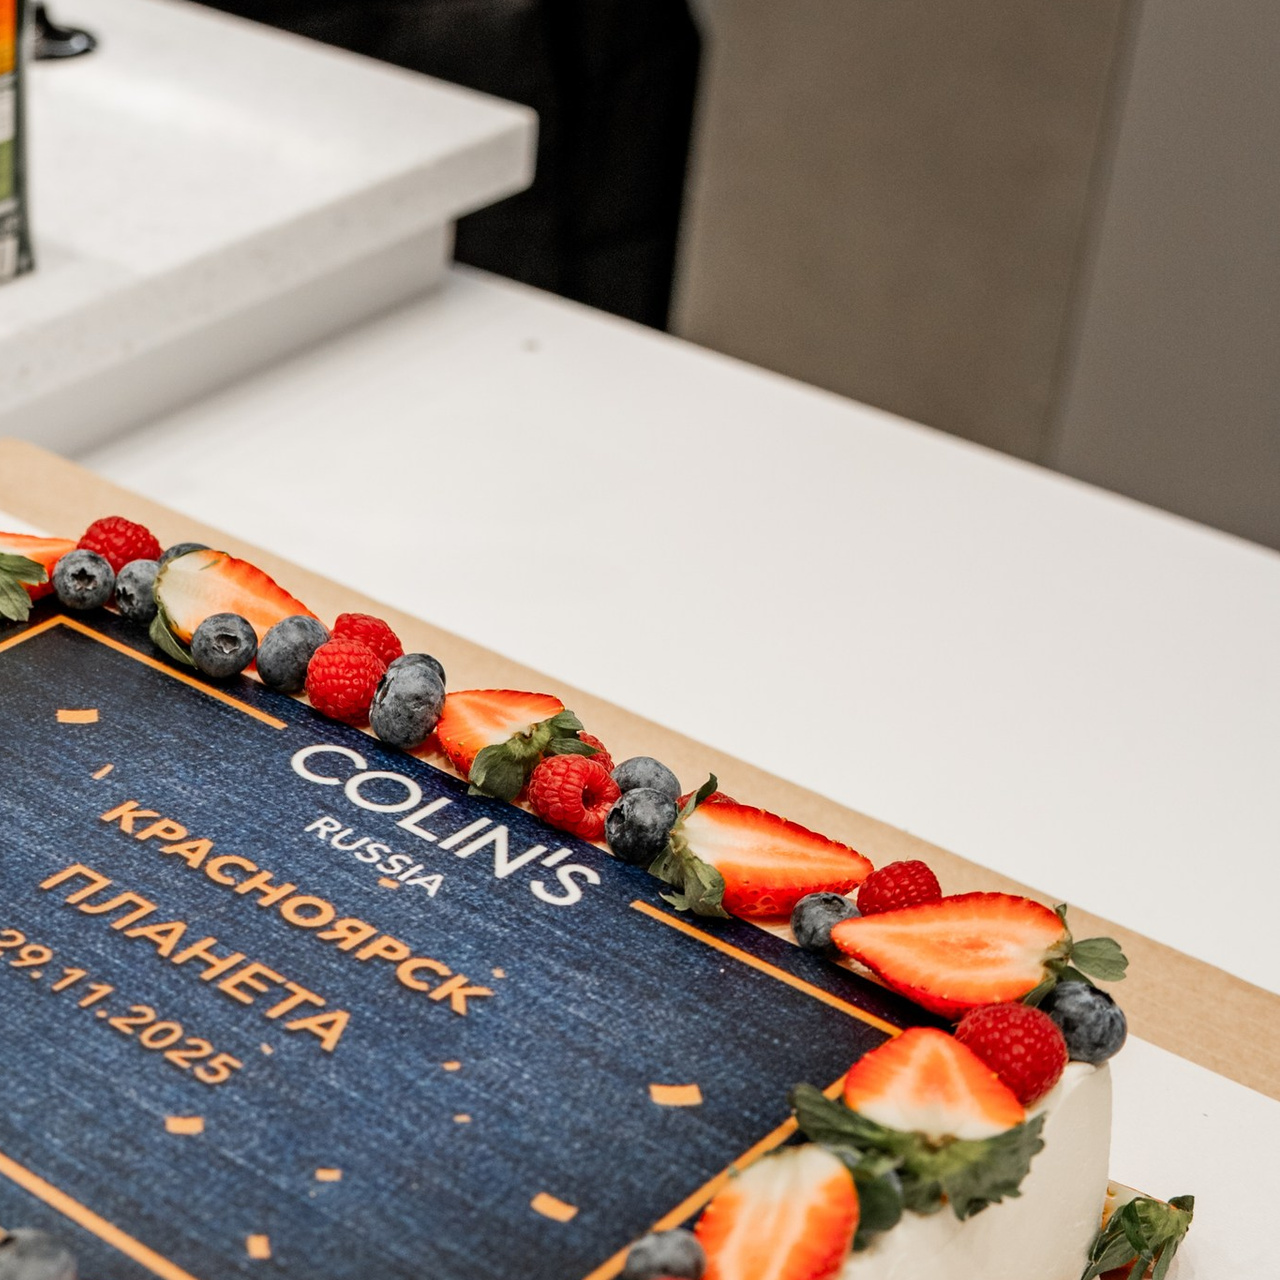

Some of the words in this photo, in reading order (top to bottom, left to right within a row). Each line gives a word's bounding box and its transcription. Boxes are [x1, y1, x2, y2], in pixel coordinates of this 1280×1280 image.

[100, 800, 494, 1016] КРАСНОЯРСК
[290, 744, 601, 907] COLIN'S
[304, 816, 445, 898] RUSSIA
[38, 863, 352, 1052] ПЛАНЕТА
